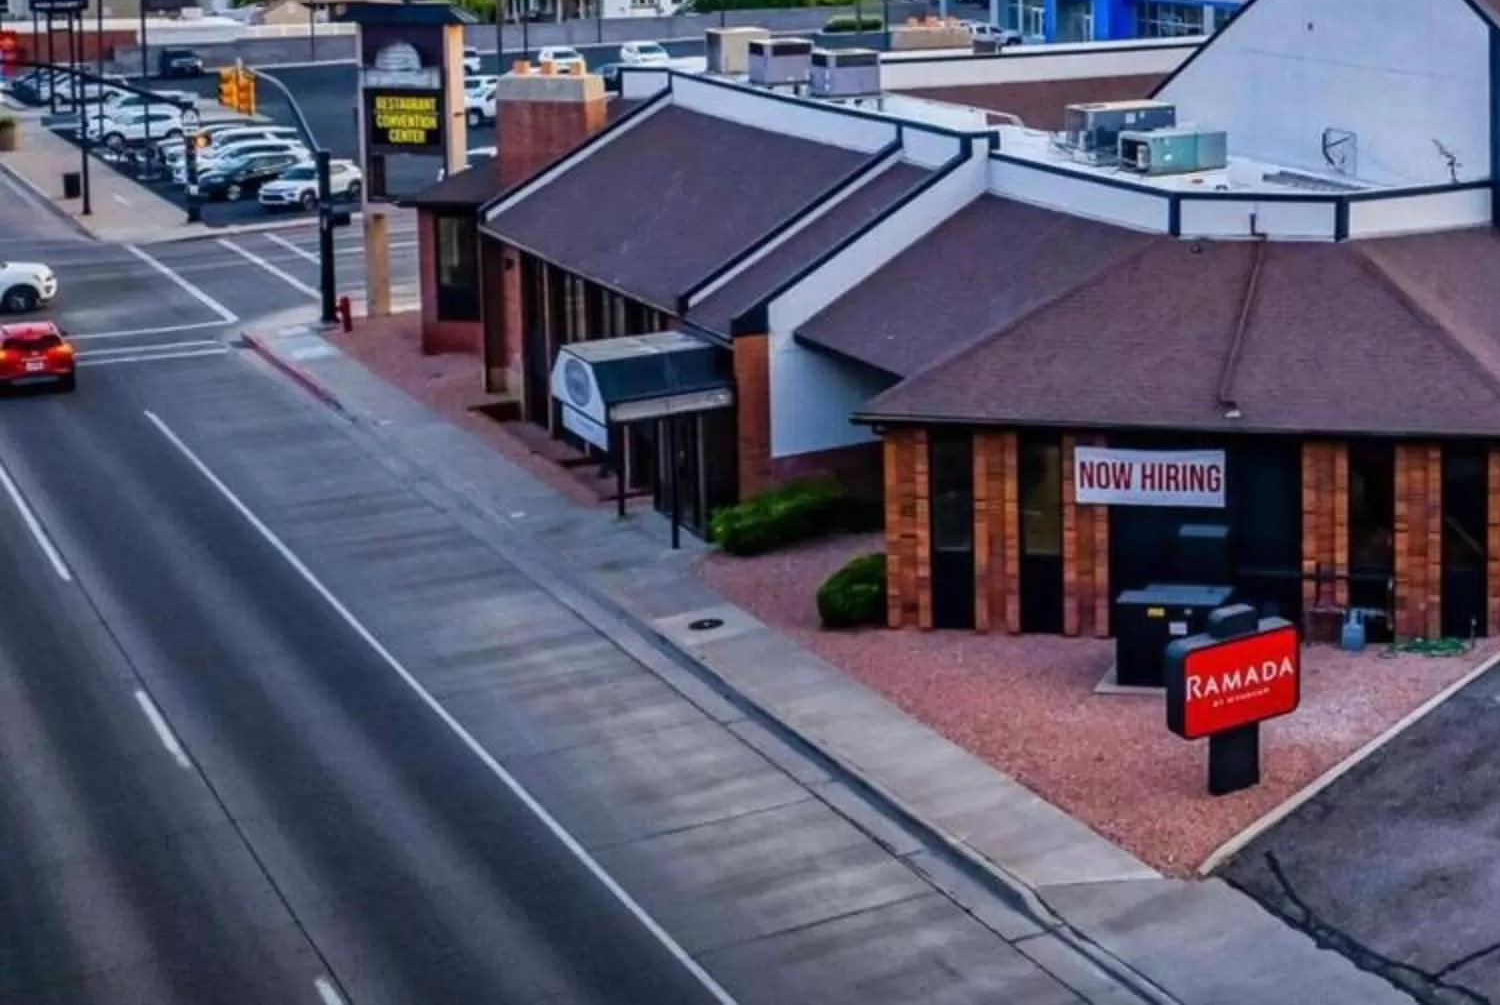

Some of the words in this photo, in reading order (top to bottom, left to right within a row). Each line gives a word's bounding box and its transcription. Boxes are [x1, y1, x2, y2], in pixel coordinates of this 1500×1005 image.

[375, 96, 436, 111] RESTAURANT
[375, 113, 438, 129] CONVENTION
[388, 128, 427, 144] CENTER
[1079, 460, 1133, 490] NOW
[1140, 461, 1221, 493] HIRING
[1185, 656, 1294, 703] RAMADA
